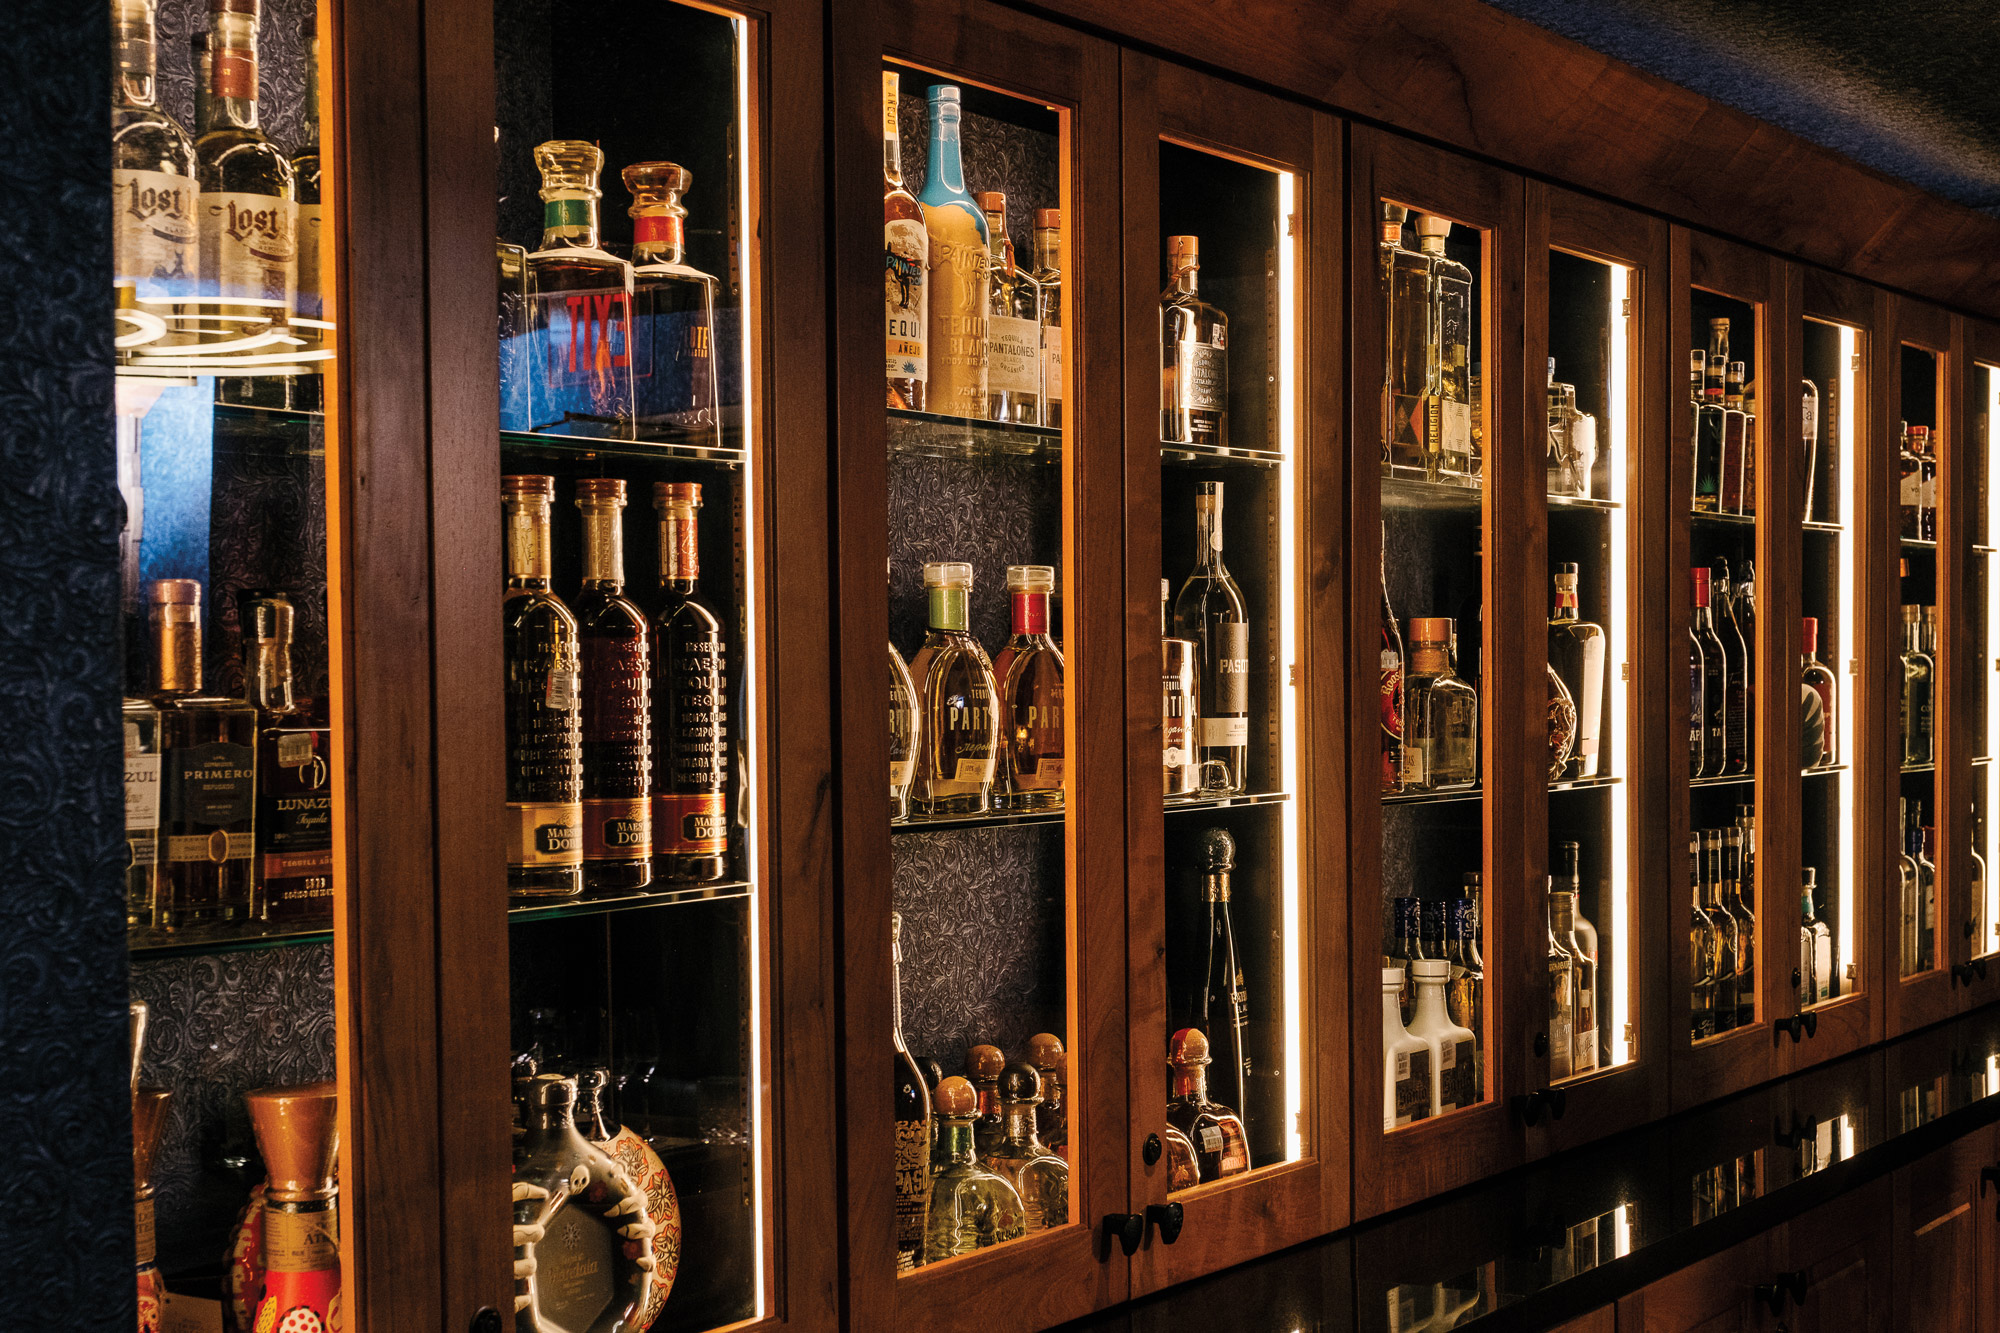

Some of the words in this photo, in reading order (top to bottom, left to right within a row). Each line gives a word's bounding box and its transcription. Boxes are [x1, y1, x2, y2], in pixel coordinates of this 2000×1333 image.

[888, 92, 897, 125] AÑEJO
[898, 342, 921, 356] AÑEJO
[989, 342, 1035, 358] PANTALONES
[1430, 404, 1440, 443] RELIGION
[184, 770, 252, 780] PRIMERO
